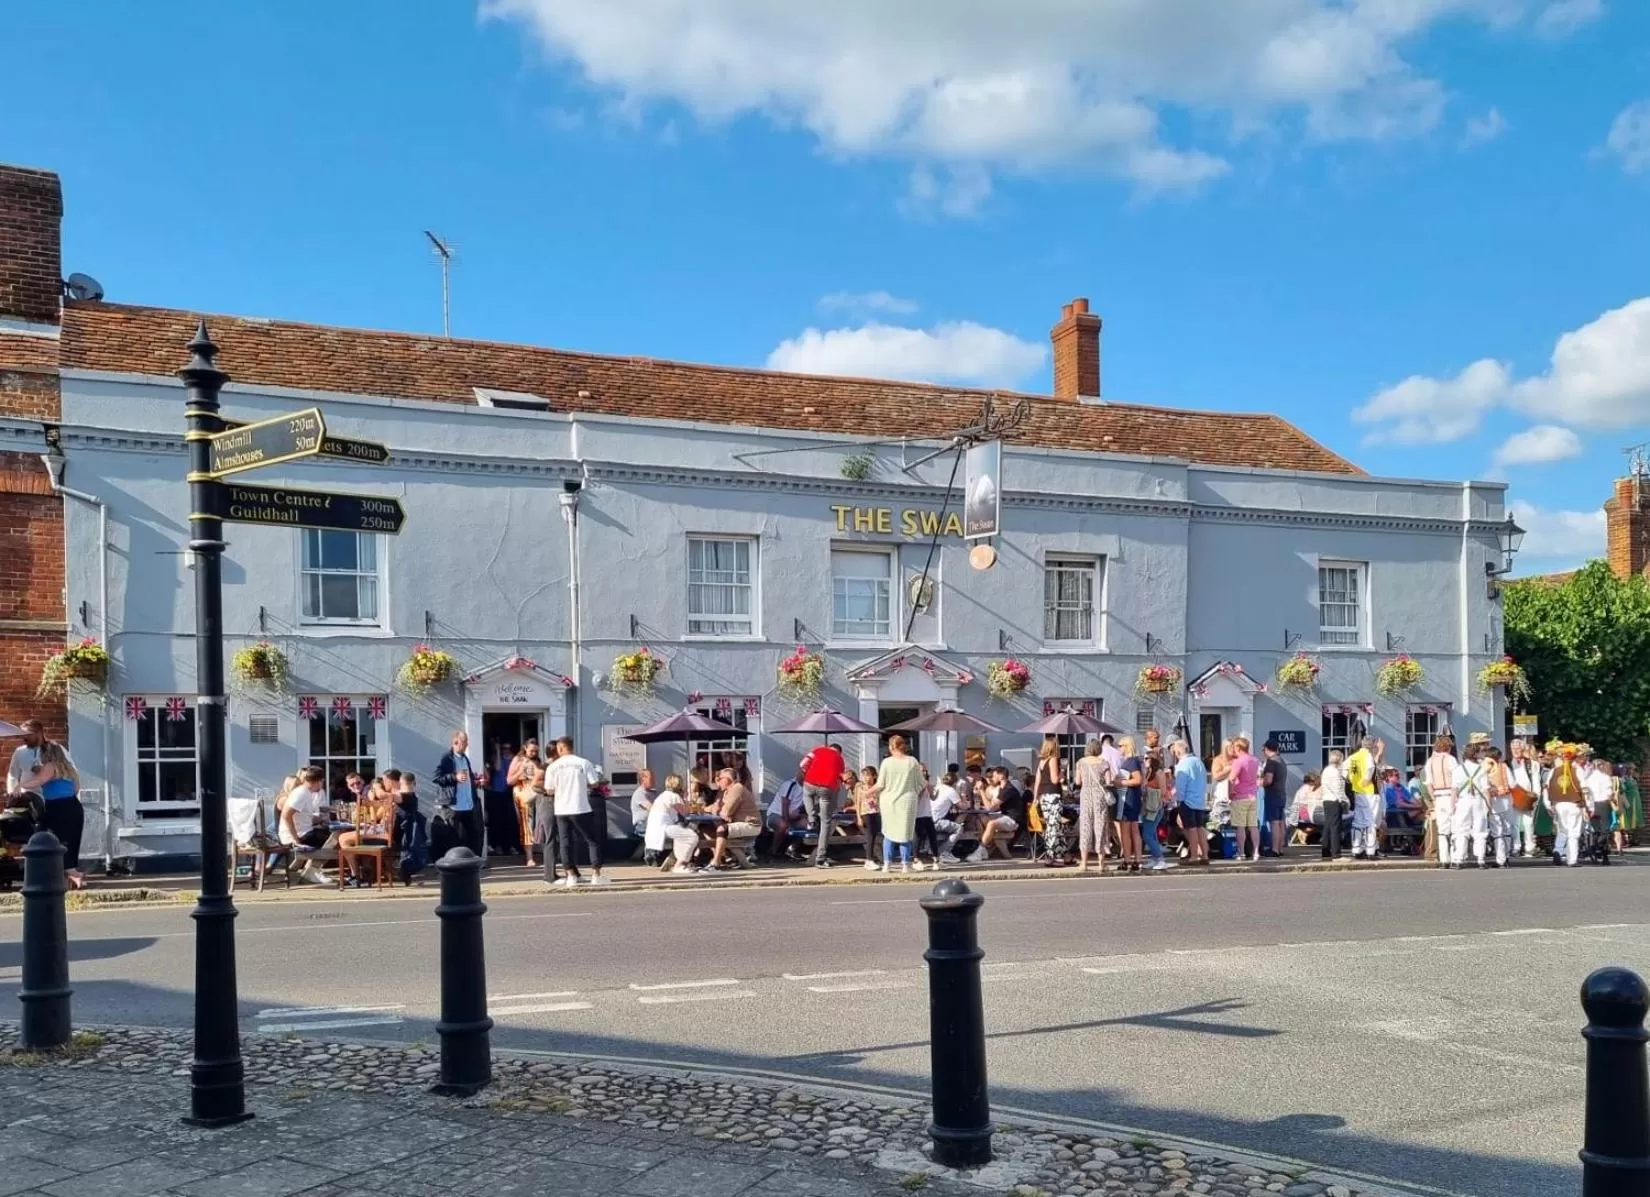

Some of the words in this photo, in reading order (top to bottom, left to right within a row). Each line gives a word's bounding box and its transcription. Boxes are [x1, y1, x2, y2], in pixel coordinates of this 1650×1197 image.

[213, 431, 252, 451] Windmill
[289, 418, 314, 433] 220m
[213, 449, 264, 471] Almshouses
[295, 436, 315, 451] 50m
[347, 443, 381, 459] 200m
[230, 487, 269, 504] Town
[273, 491, 322, 508] Centre
[360, 500, 395, 514] 300m
[229, 504, 299, 522] Guildhall
[360, 516, 395, 530] 250m
[831, 504, 893, 534] THE
[901, 510, 964, 537] SWA
[1278, 732, 1296, 742] CAR
